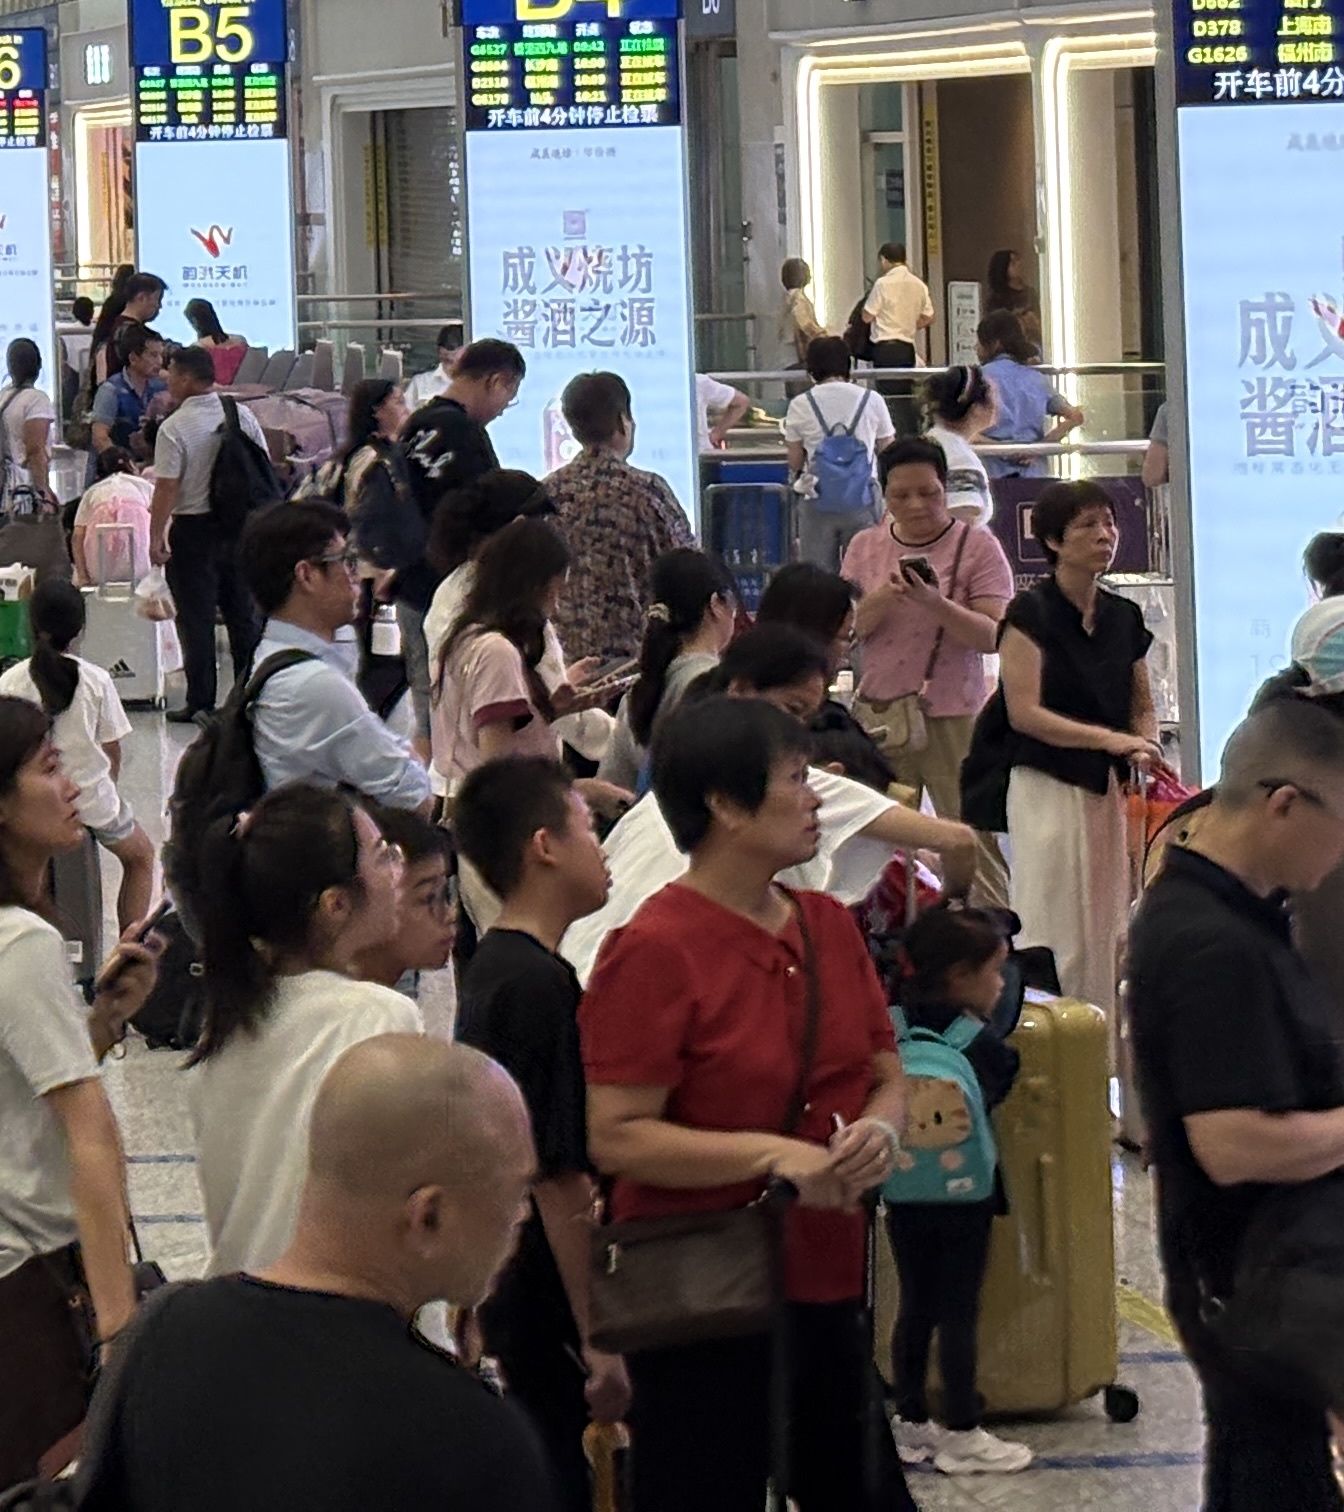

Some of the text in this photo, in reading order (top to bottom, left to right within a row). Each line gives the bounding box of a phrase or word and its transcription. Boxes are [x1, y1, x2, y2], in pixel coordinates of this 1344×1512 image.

[170, 6, 253, 64] B5
[1193, 15, 1332, 37] D378 上海南
[1188, 45, 1248, 64] G1626
[487, 104, 659, 128] 开车前4分钟停止检票
[503, 244, 653, 295] 成义烧坊
[502, 297, 657, 349] 酱酒之源
